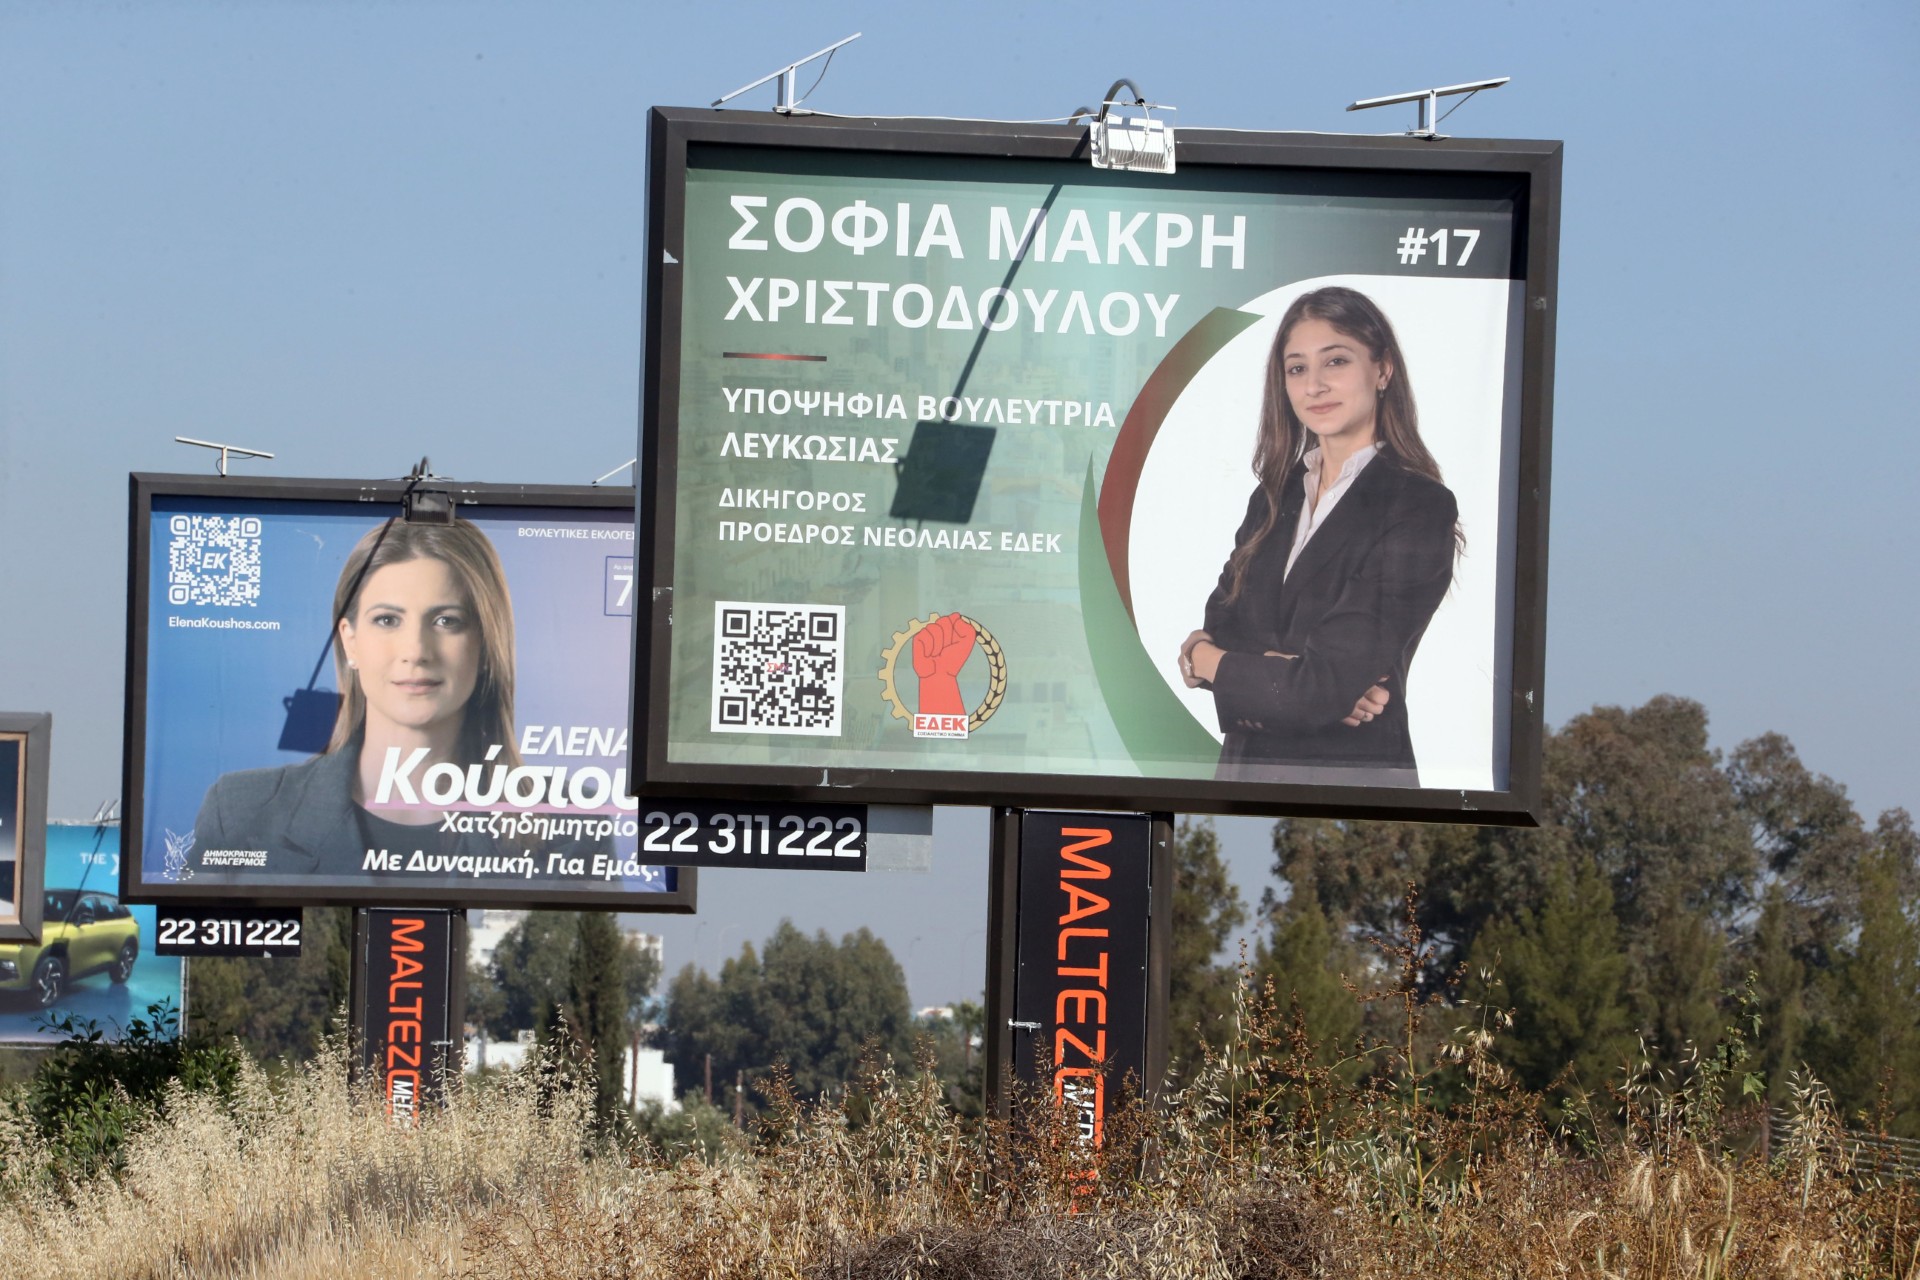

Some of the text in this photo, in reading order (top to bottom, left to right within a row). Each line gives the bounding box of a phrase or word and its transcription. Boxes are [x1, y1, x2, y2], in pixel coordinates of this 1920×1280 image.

[728, 194, 1247, 271] ΣΟΦΙΑ ΜΑΚΡΗ
[1396, 227, 1481, 267] #17
[724, 275, 1181, 338] ΧΡΙΣΤΟΔΟΥΛΟΥ
[721, 387, 1116, 428] ΥΠΟΨΗΦΙΑ ΒΟΥΛΕΥΤΡΙΑ
[720, 432, 899, 464] ΛΕΥΚΩΣΙΑΣ
[718, 488, 866, 512] ΔΙΚΗΓΟΡΟΣ
[518, 527, 635, 540] ΒΟΥΛΕΥΤΙΚΕΣ ΕΚΛΟΓΕ
[718, 521, 1062, 553] ΠΡΟΕΔΡΟΣ ΝΕΟΛΑΙΑΣ ΕΔΕΚ
[202, 553, 228, 569] EK
[168, 616, 281, 631] ElenaKoushos.com
[915, 716, 966, 731] ΕΔΕΚ
[643, 811, 862, 858] 22 311 222
[80, 852, 107, 865] THE
[201, 857, 267, 866] ΣΥΝΑΓΕΡΜΟΣ
[203, 850, 268, 858] ΔΗΜΟΚΡΑΤΙΚΟΣ
[362, 849, 660, 882] Με Δυναμική. Για Εμάς.
[159, 918, 300, 946] 22 311 222
